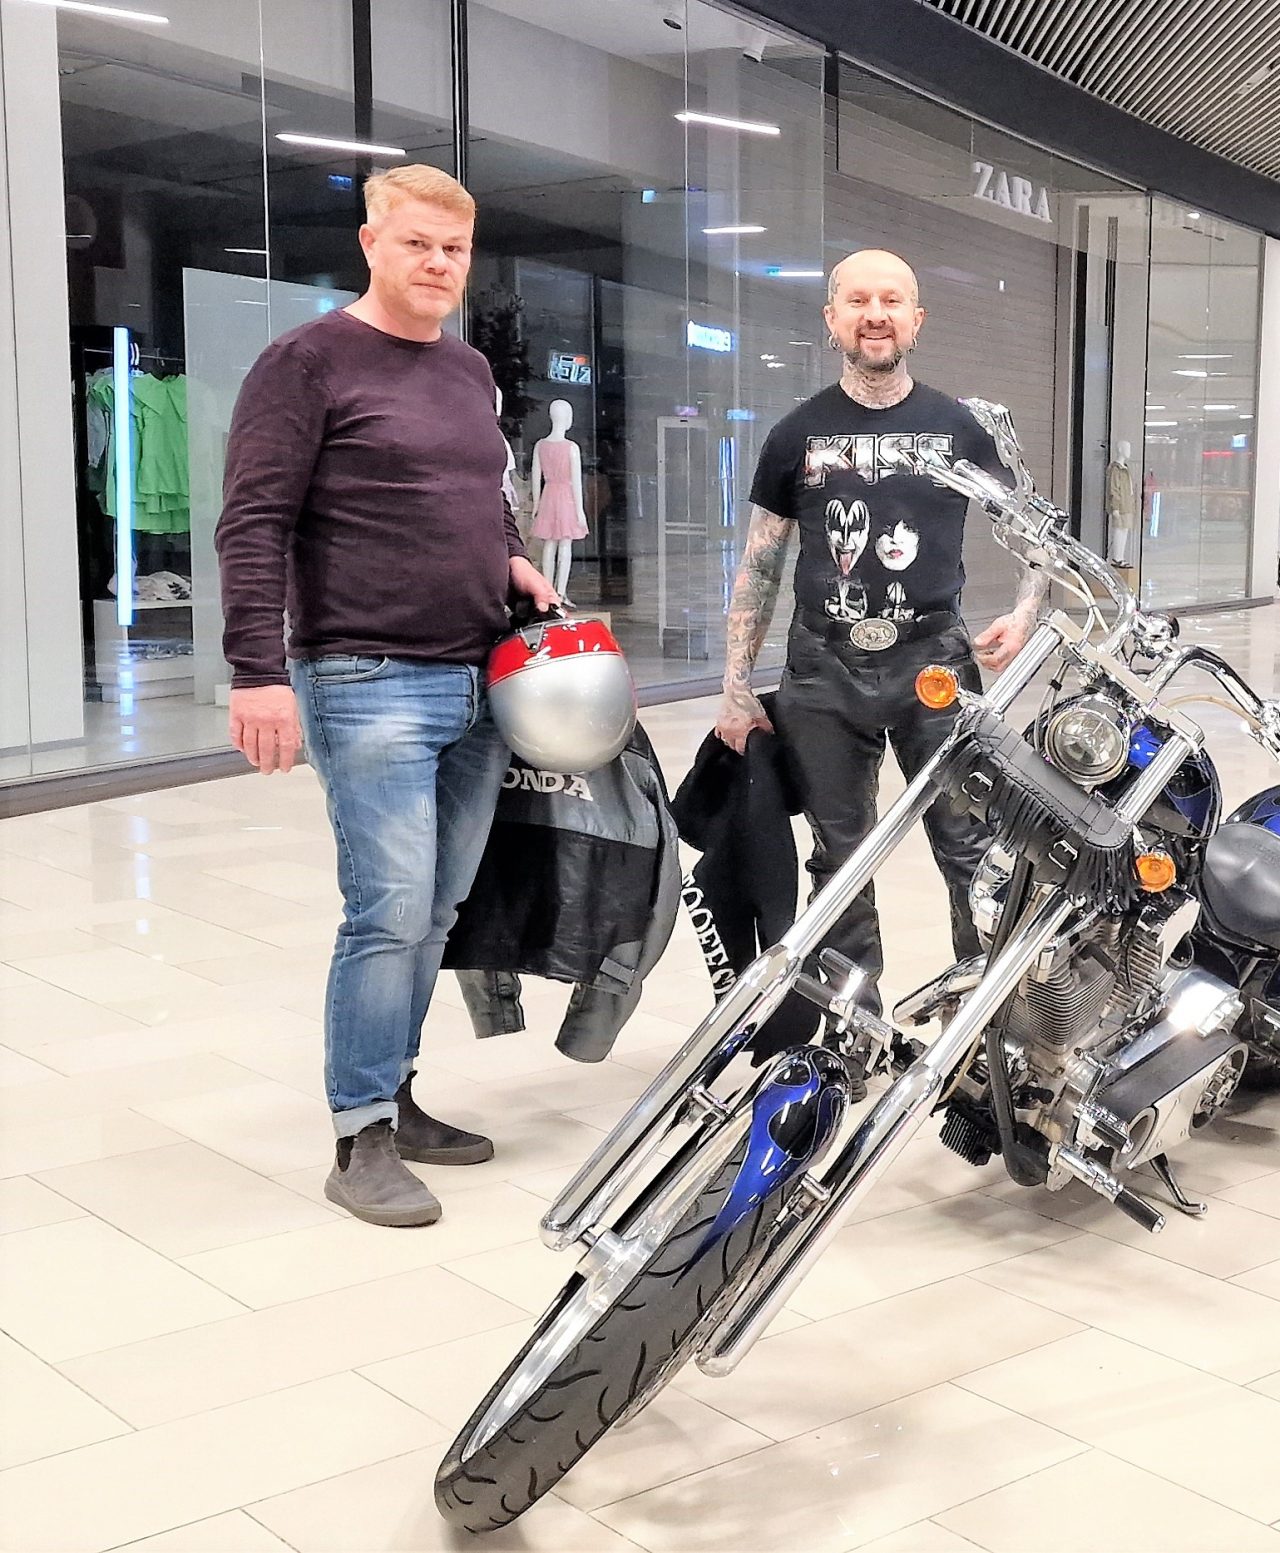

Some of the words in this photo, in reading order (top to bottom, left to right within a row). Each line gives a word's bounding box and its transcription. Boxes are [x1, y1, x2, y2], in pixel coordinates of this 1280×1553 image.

[974, 161, 1053, 223] ZARA
[804, 433, 954, 489] KISS
[500, 767, 594, 802] ONDA
